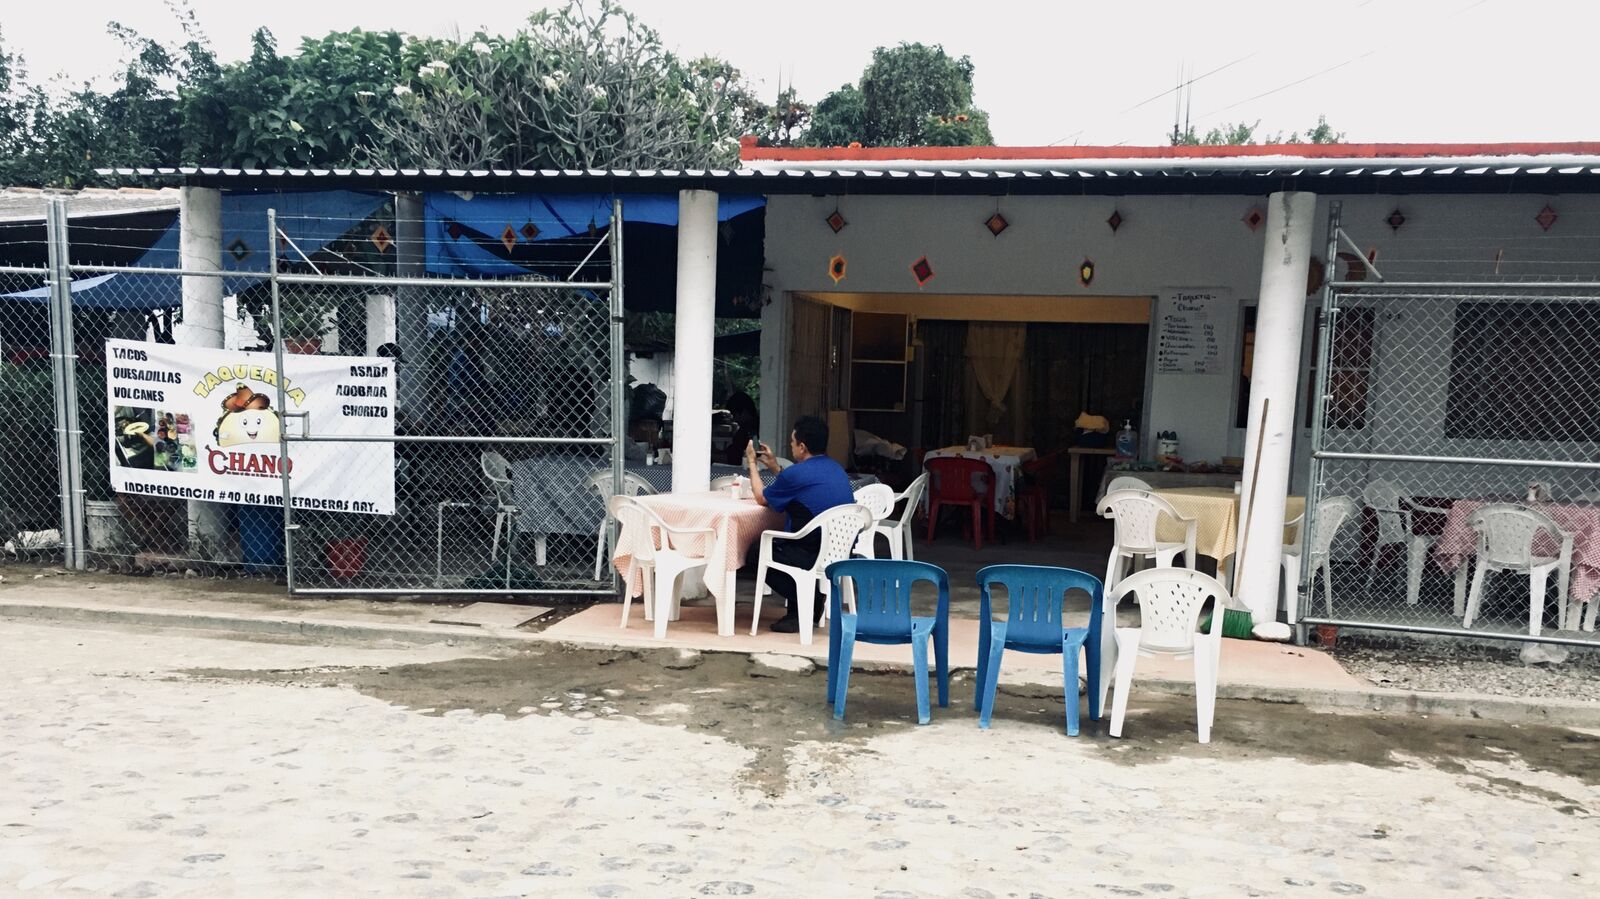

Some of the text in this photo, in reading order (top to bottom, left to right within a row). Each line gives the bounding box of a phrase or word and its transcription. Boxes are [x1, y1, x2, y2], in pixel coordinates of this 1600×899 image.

[113, 347, 148, 361] TACOS
[113, 367, 182, 384] QUESADILLAS
[193, 363, 307, 407] TAQUERIA
[336, 384, 388, 398] ADOBADA
[113, 386, 165, 403] VOLCANES
[342, 404, 388, 418] CHORIZO
[205, 444, 293, 475] CHANO
[125, 481, 215, 500] INDEPENDENCIA
[244, 493, 261, 504] LAS
[263, 494, 349, 510] JARETADERAS
